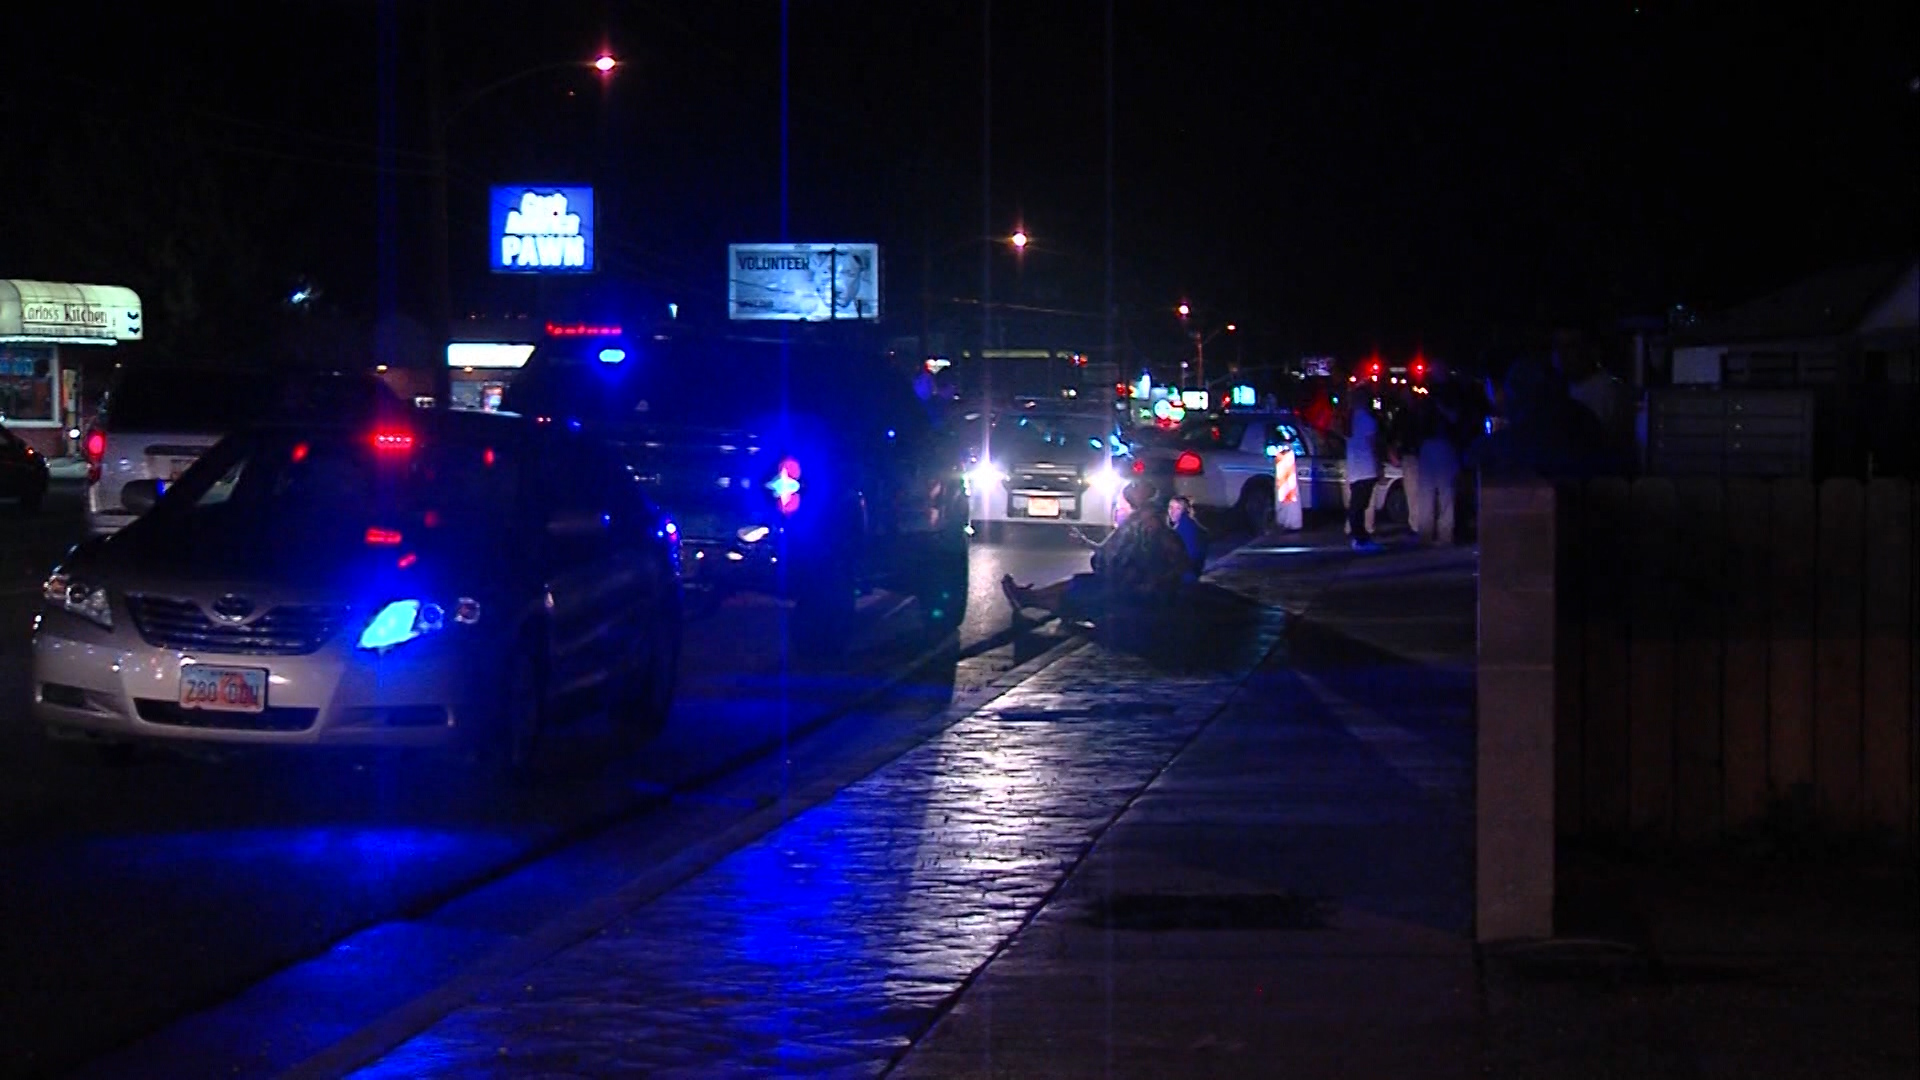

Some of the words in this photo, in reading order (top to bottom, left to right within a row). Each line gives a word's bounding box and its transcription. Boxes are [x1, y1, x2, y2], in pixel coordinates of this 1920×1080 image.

[502, 235, 584, 266] PAWN
[739, 256, 810, 270] VOLUNTEER
[64, 303, 107, 323] Kitchen
